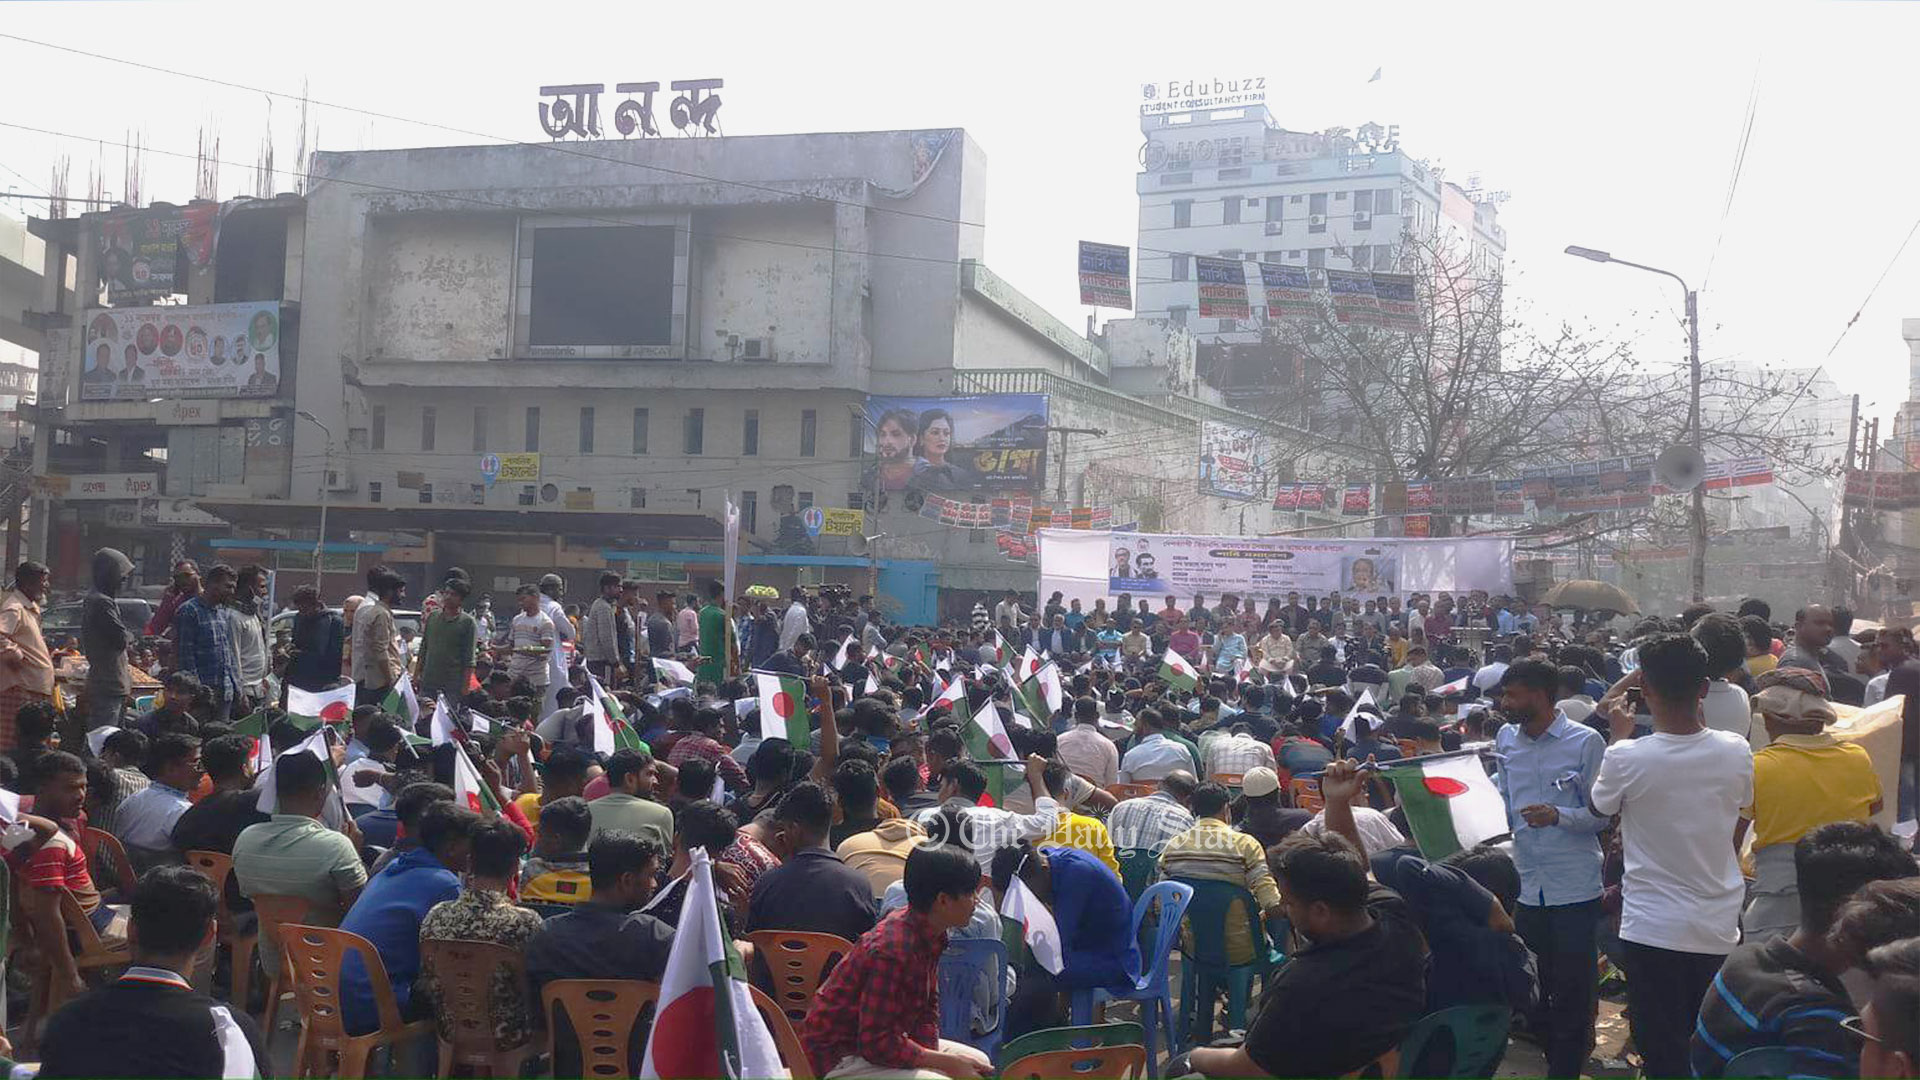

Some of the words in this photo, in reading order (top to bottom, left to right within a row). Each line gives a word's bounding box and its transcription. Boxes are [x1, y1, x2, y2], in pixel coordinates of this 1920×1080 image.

[1168, 77, 1267, 99] Edubuzz
[538, 78, 724, 139] আনন্দ
[1140, 100, 1177, 113] STUDENT
[1180, 95, 1242, 108] CONSULTANCY
[1177, 136, 1257, 163] HOTEL
[125, 476, 153, 493] Apex
